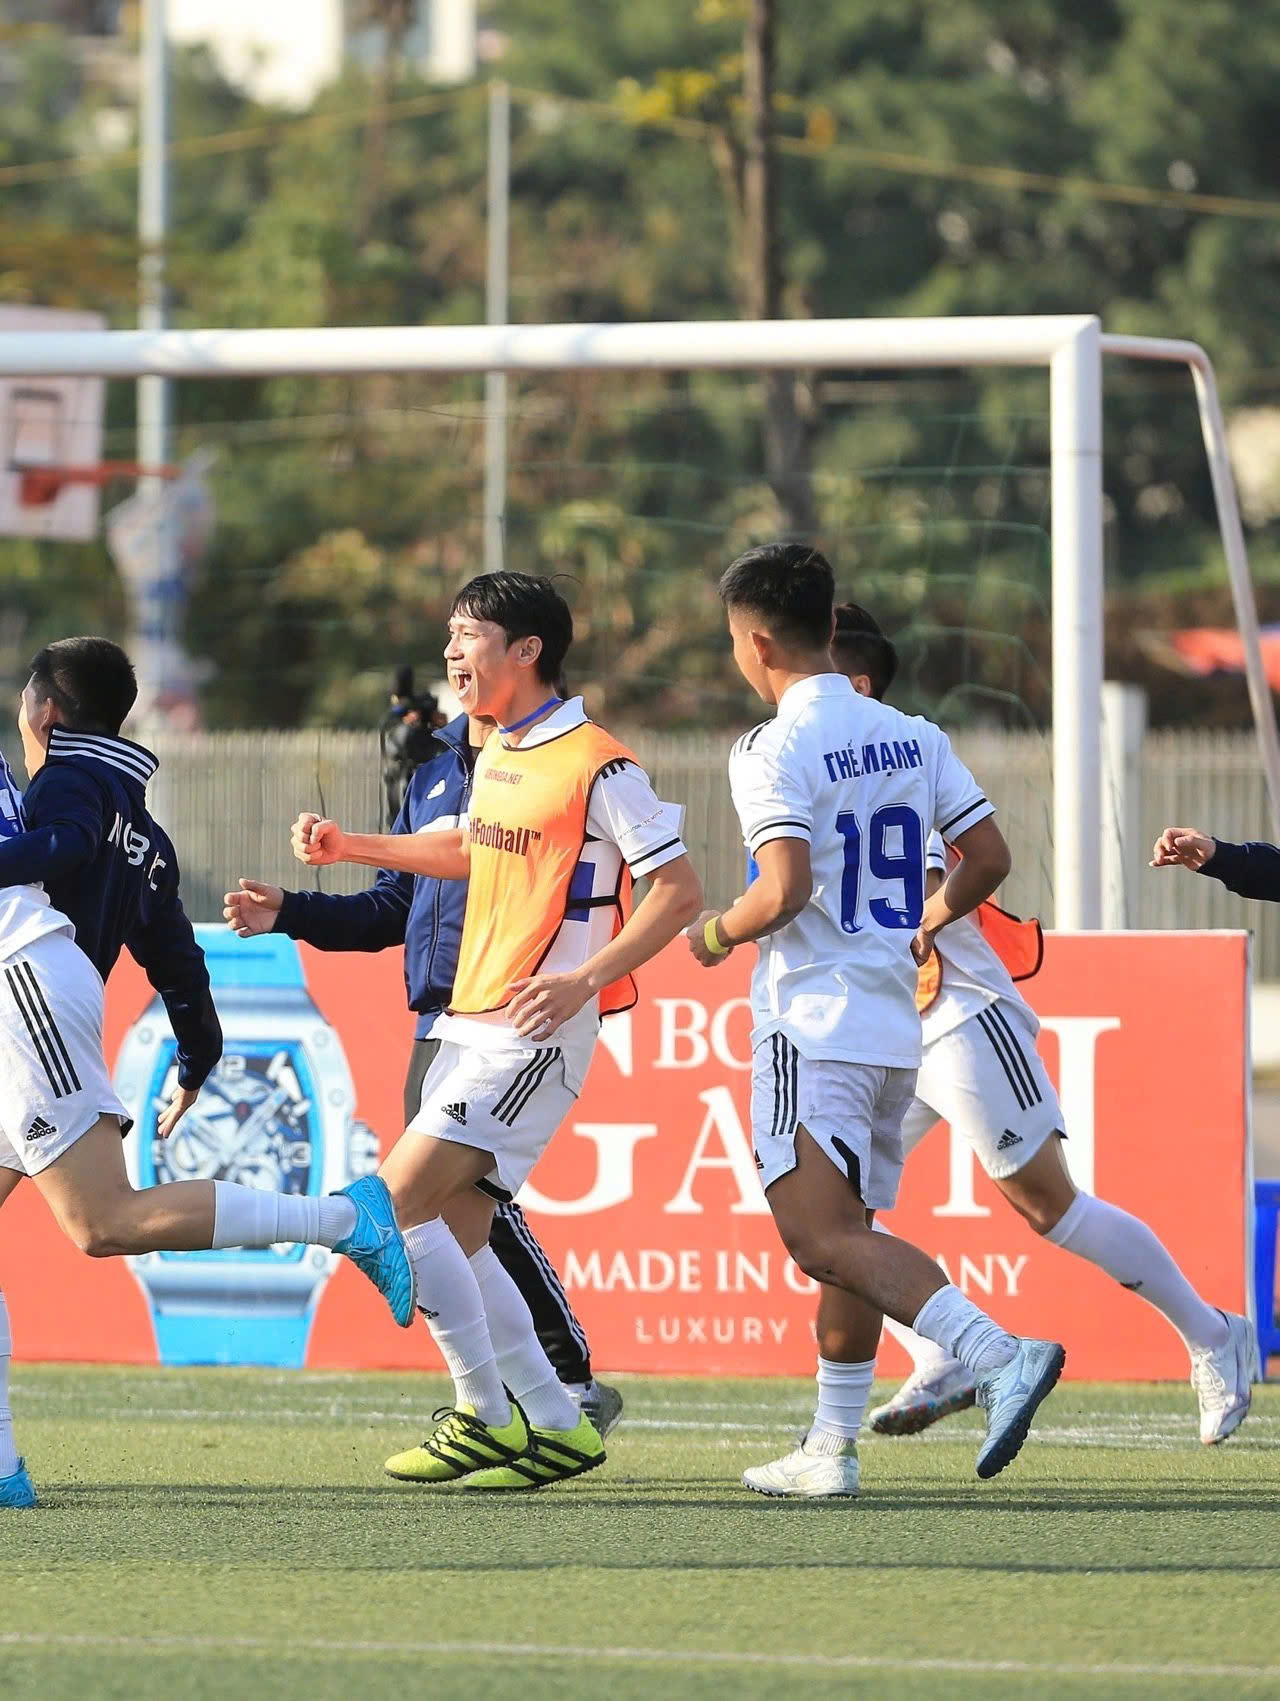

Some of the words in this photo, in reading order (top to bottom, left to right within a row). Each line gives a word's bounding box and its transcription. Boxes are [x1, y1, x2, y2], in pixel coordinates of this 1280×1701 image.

[835, 802, 927, 934] 19
[441, 1105, 468, 1126] adidas
[26, 1126, 57, 1141] adidas
[563, 1250, 702, 1293] MADE
[716, 1251, 770, 1294] IN
[635, 1317, 788, 1345] LUXURY
